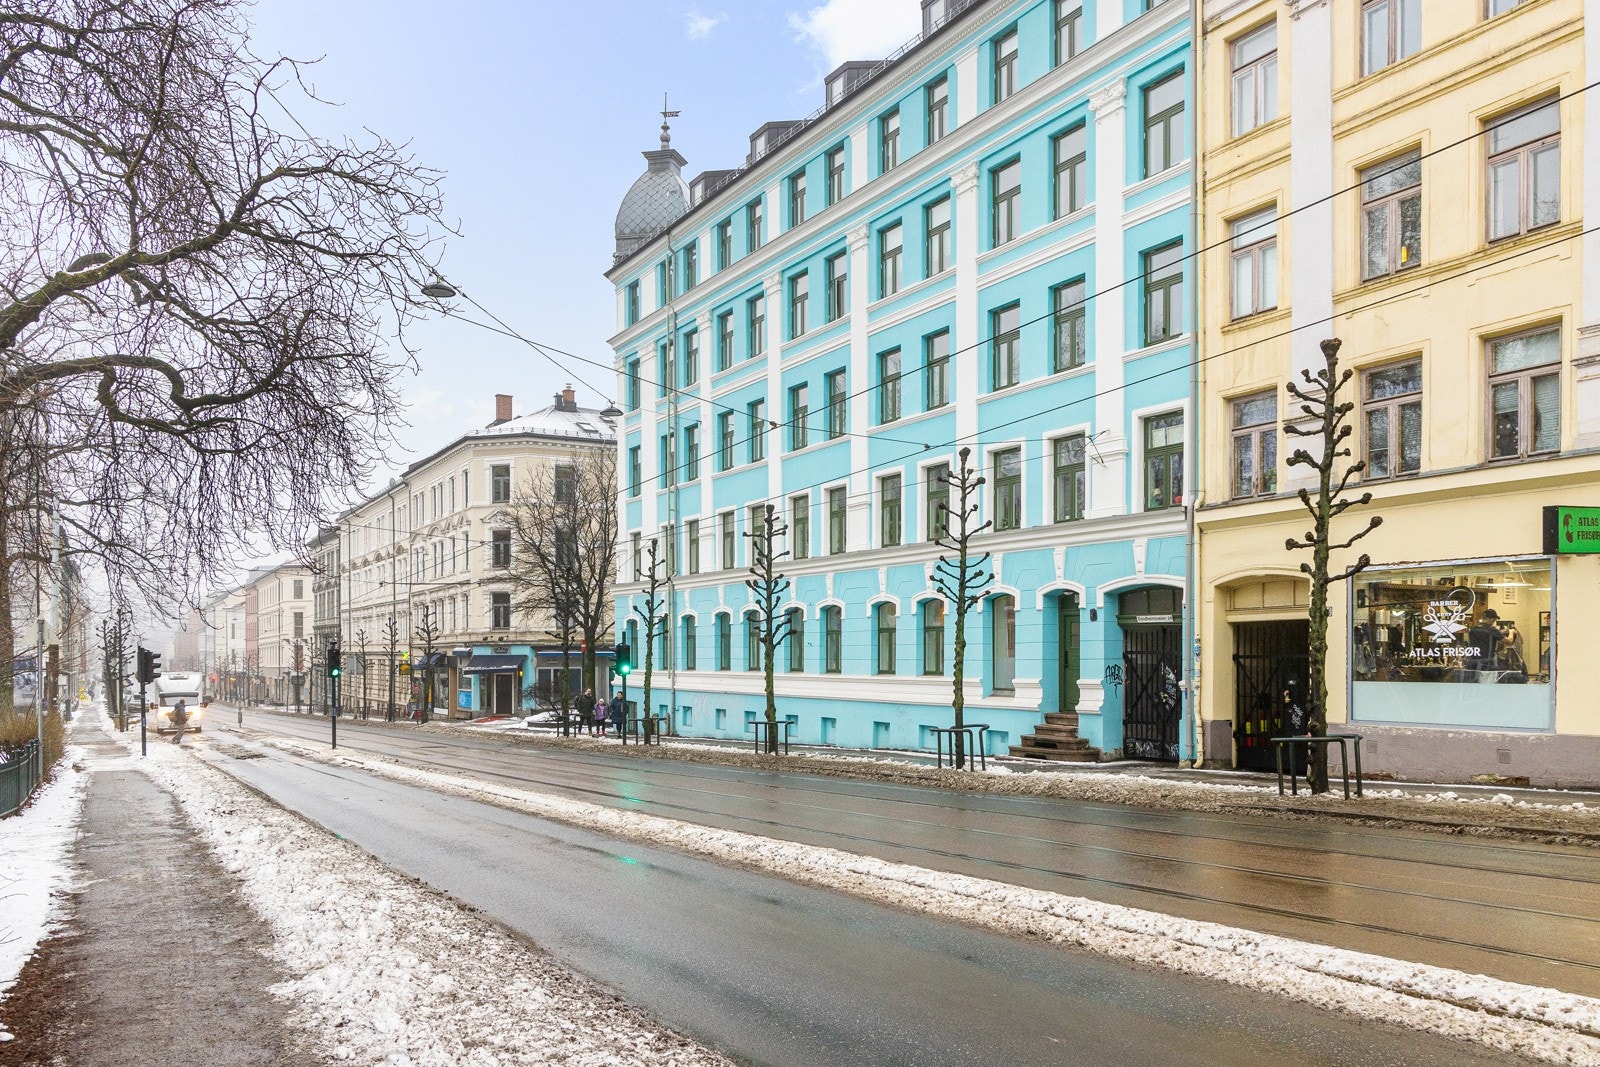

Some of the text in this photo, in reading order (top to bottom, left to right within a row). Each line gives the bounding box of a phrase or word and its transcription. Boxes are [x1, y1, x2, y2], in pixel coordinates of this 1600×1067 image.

[1578, 516, 1599, 527] ATLAS
[1409, 646, 1481, 658] ATLAS FRISØR
